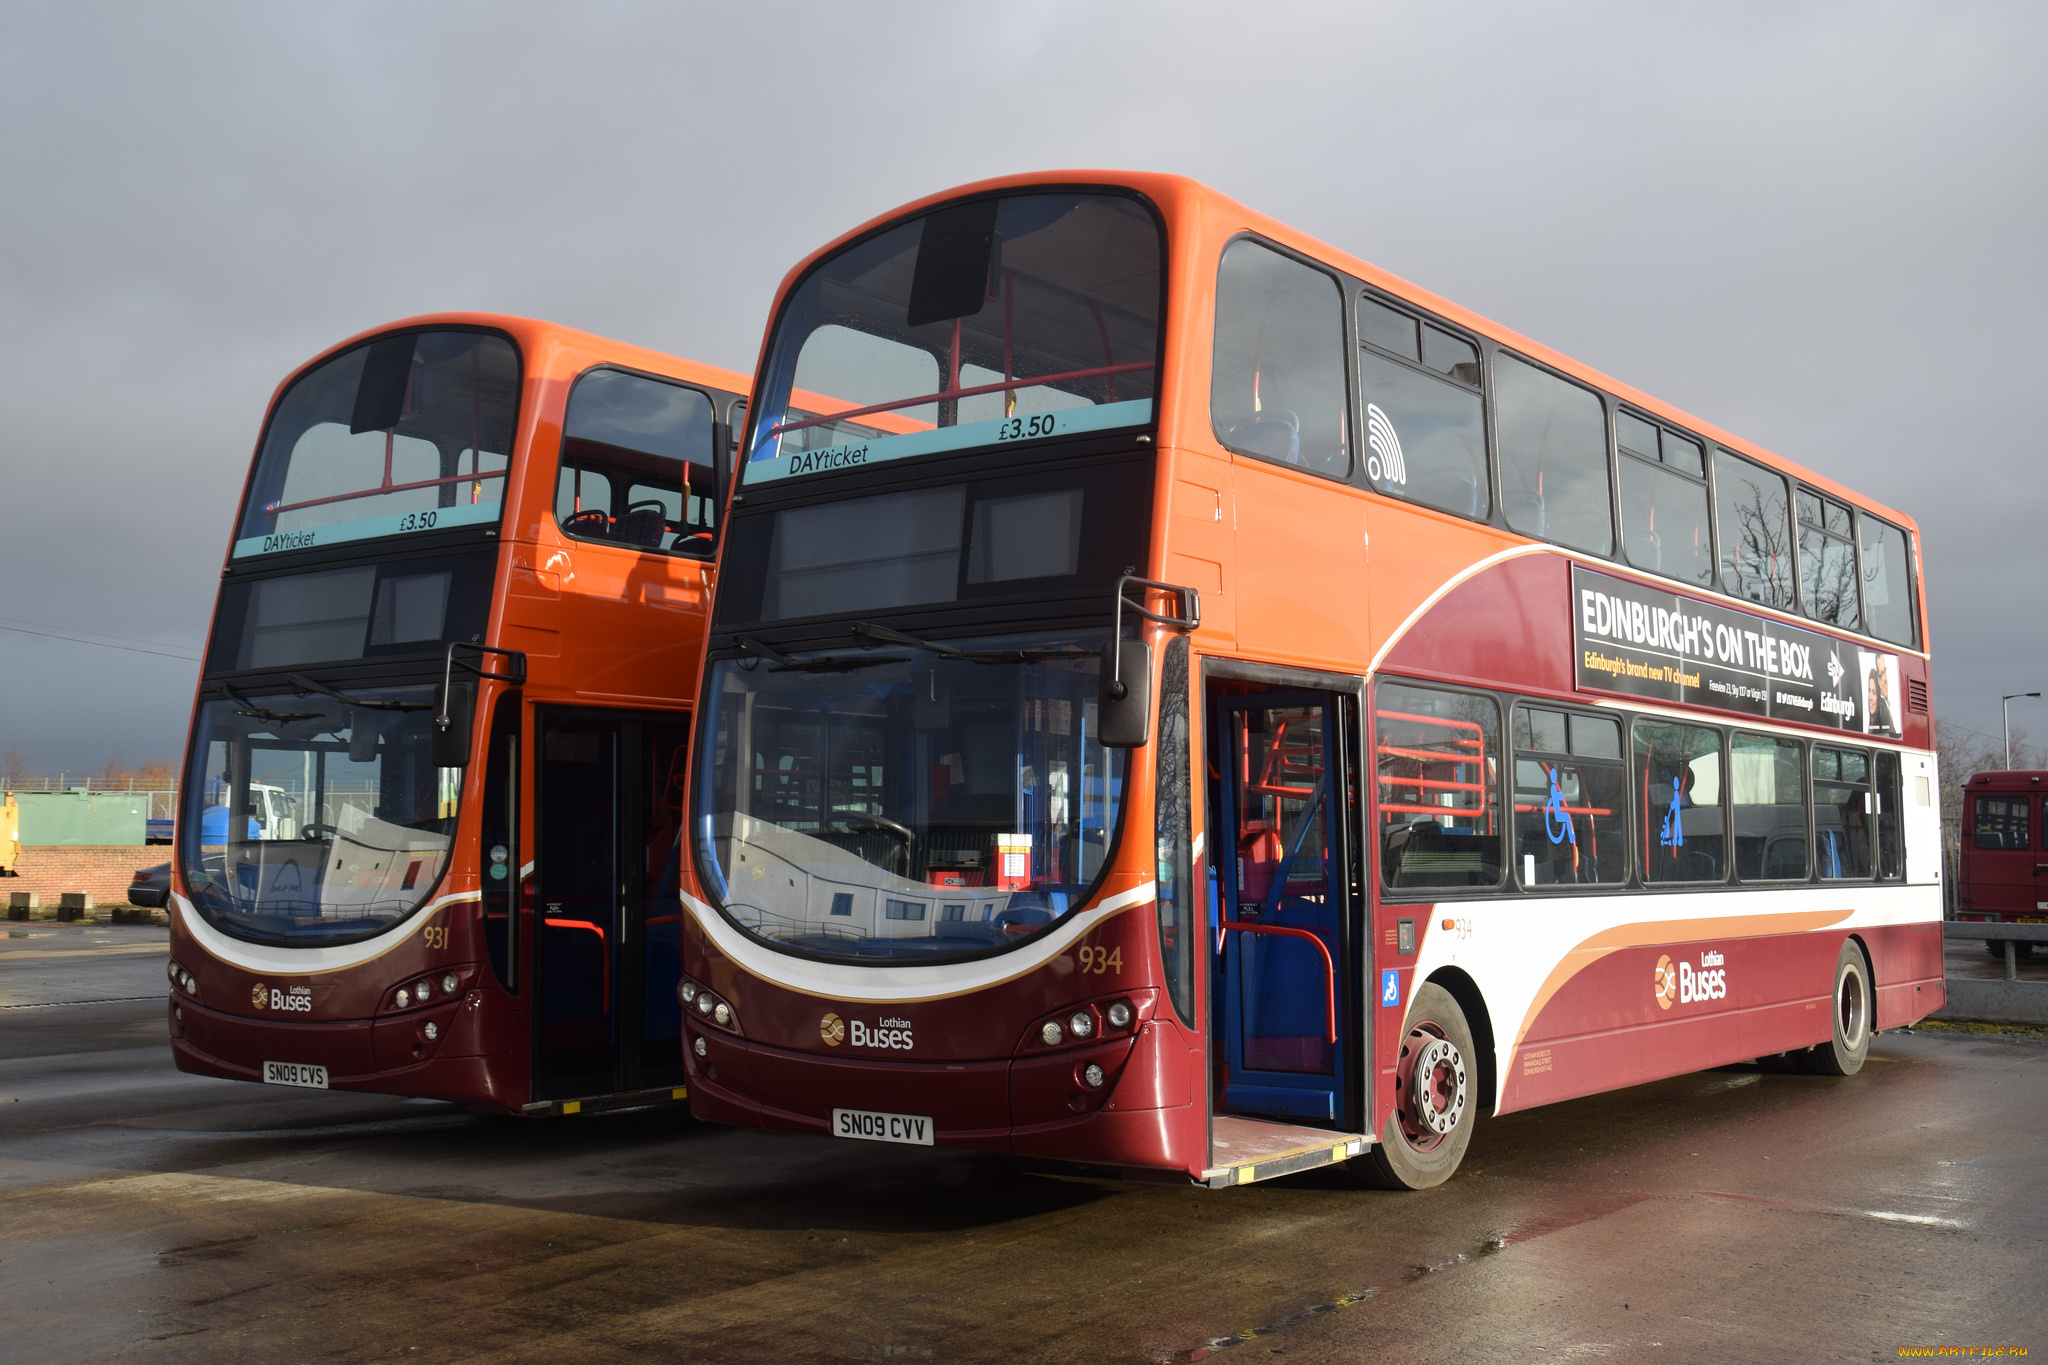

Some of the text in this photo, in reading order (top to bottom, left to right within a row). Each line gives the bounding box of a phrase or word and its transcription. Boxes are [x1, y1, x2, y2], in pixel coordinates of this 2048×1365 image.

[789, 414, 1055, 474] DAYticket £3.50
[263, 511, 437, 552] DAYticket £3.50
[1581, 589, 1814, 680] EDINBURGH'S ON THE BOX
[1584, 651, 1700, 688] Edinburgh's brand new TV channel
[1820, 691, 1855, 721] Edinburgh
[424, 926, 449, 950] 931
[1456, 918, 1472, 939] 934
[1079, 946, 1123, 974] 934
[1701, 950, 1724, 967] Lothian
[290, 986, 311, 995] Lothian
[1679, 962, 1726, 1003] Buses
[271, 989, 312, 1012] Buses
[850, 1020, 914, 1050] Buses
[880, 1017, 911, 1029] Lothian
[268, 1064, 324, 1085] SN09 CVS
[840, 1113, 925, 1140] SN09 CVV
